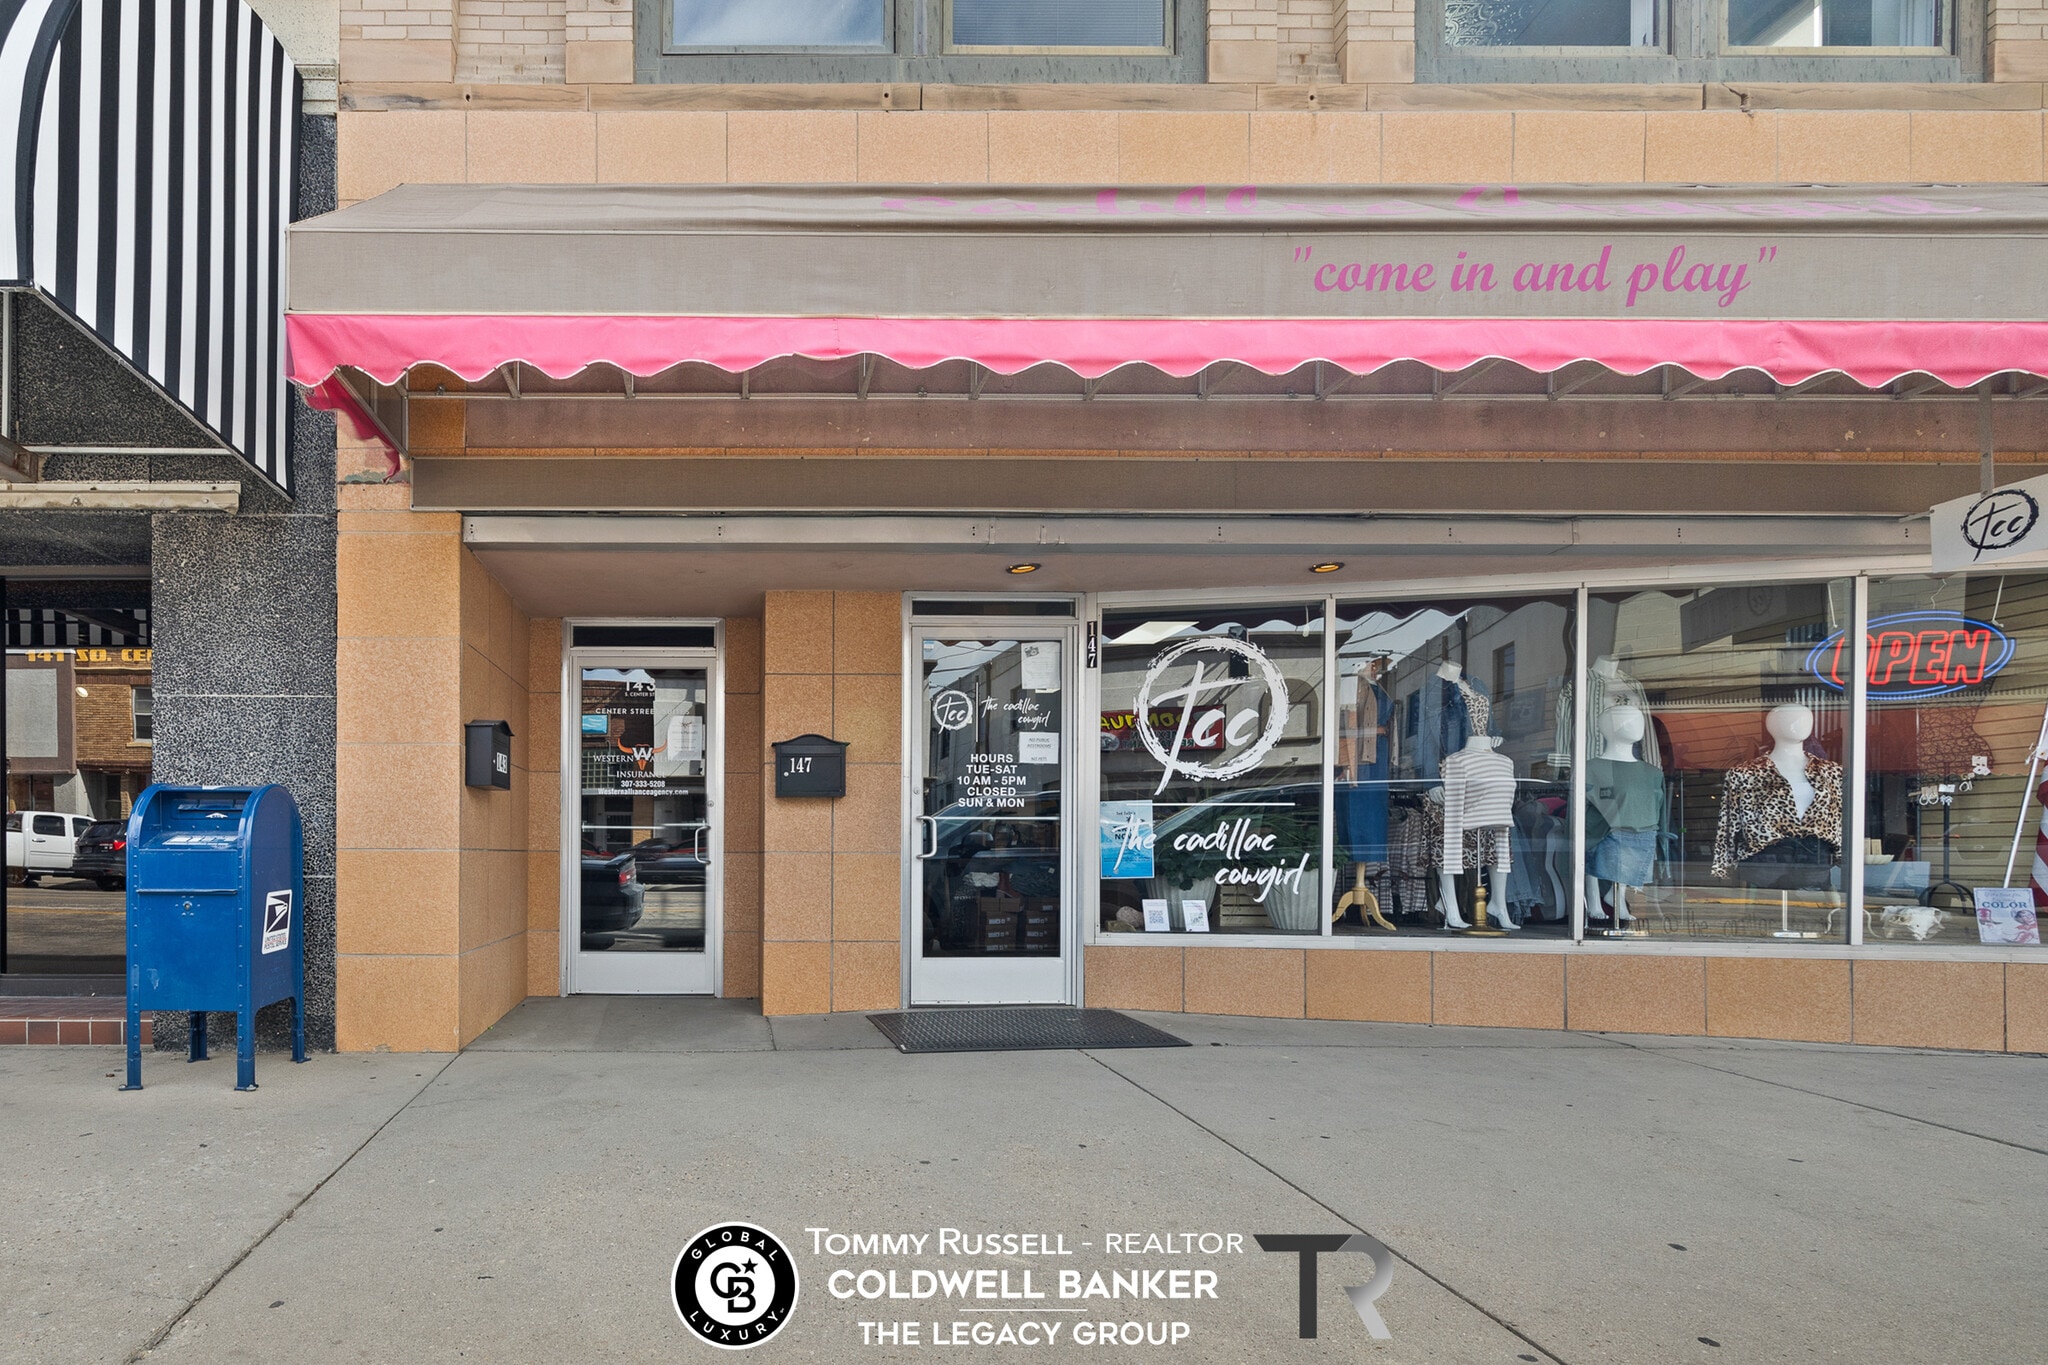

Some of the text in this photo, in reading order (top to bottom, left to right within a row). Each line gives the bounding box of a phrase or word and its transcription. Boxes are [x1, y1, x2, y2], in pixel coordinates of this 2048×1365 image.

[1450, 251, 1498, 293] in
[1512, 245, 1612, 293] and
[1088, 621, 1097, 667] 147
[25, 649, 65, 662] 141
[121, 648, 152, 662] CE
[1831, 630, 1991, 684] OPEN
[625, 678, 656, 692] 143
[595, 707, 627, 715] CENTER
[630, 707, 660, 715] STREE
[1003, 697, 1040, 714] cadillac
[1017, 711, 1051, 730] cowgirl
[593, 754, 634, 762] WESTERN
[790, 757, 812, 773] 147
[970, 753, 1014, 763] HOURS
[966, 764, 1018, 774] TUE-SAT
[620, 780, 666, 788] 307-333-5208
[957, 776, 971, 785] 10
[972, 776, 991, 785] AM
[1001, 776, 1027, 785] 5PM
[967, 786, 1017, 796] CLOSED
[958, 797, 1025, 808] SUN & MON
[1173, 817, 1277, 860] cadillac
[1214, 852, 1310, 903] cowgirl
[1981, 901, 2028, 909] COLOR
